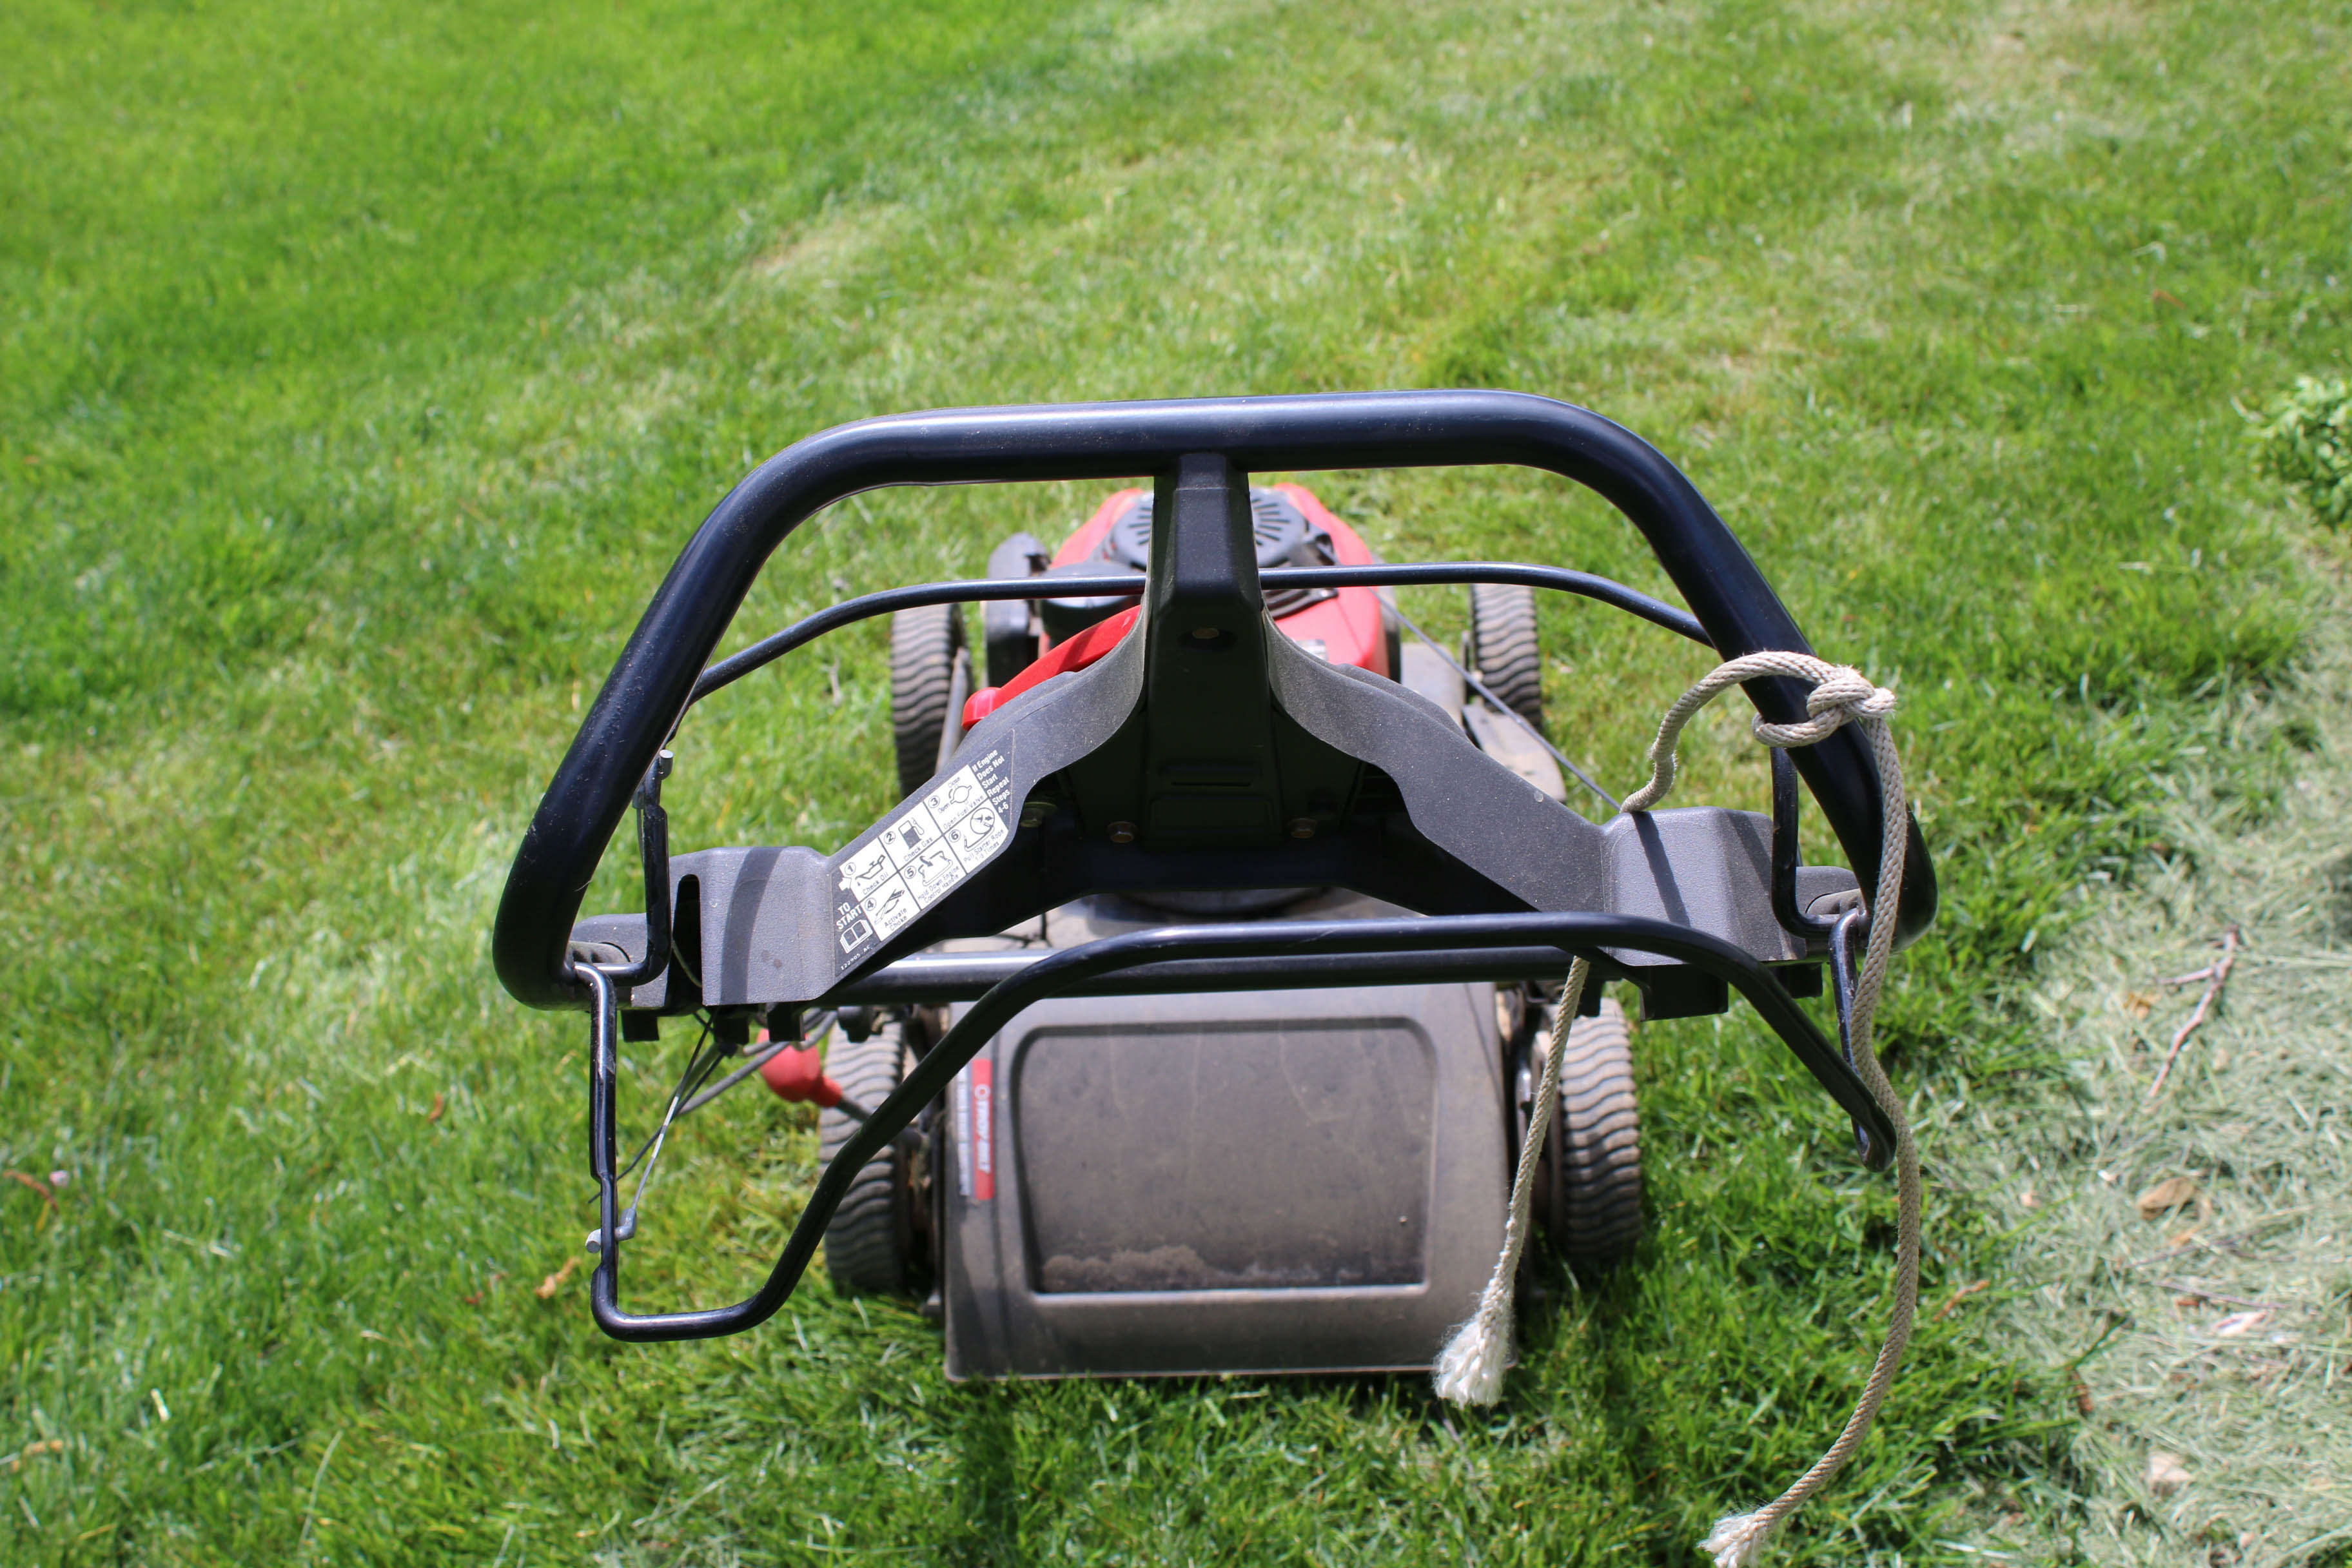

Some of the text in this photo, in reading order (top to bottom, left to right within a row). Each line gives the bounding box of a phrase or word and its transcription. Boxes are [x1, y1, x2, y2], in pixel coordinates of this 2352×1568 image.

[977, 750, 998, 769] Engine
[977, 756, 1004, 780] Does Not
[982, 774, 998, 789] Start
[986, 776, 1010, 797] Repeat
[992, 789, 1010, 805] Steps
[938, 803, 950, 813] Open
[943, 796, 984, 829] Open Fuel Valve
[998, 802, 1008, 813] 4-6
[904, 838, 933, 861] Check Gas
[964, 829, 1004, 863] Pull Starter Rope
[984, 841, 999, 855] Times
[863, 872, 888, 895] Check Oil
[917, 867, 959, 900] Hold Down Engine
[924, 874, 959, 903] Control Handle
[836, 905, 863, 930] START
[838, 902, 850, 915] TO
[885, 908, 906, 927] Activate
[890, 916, 907, 930] Choke
